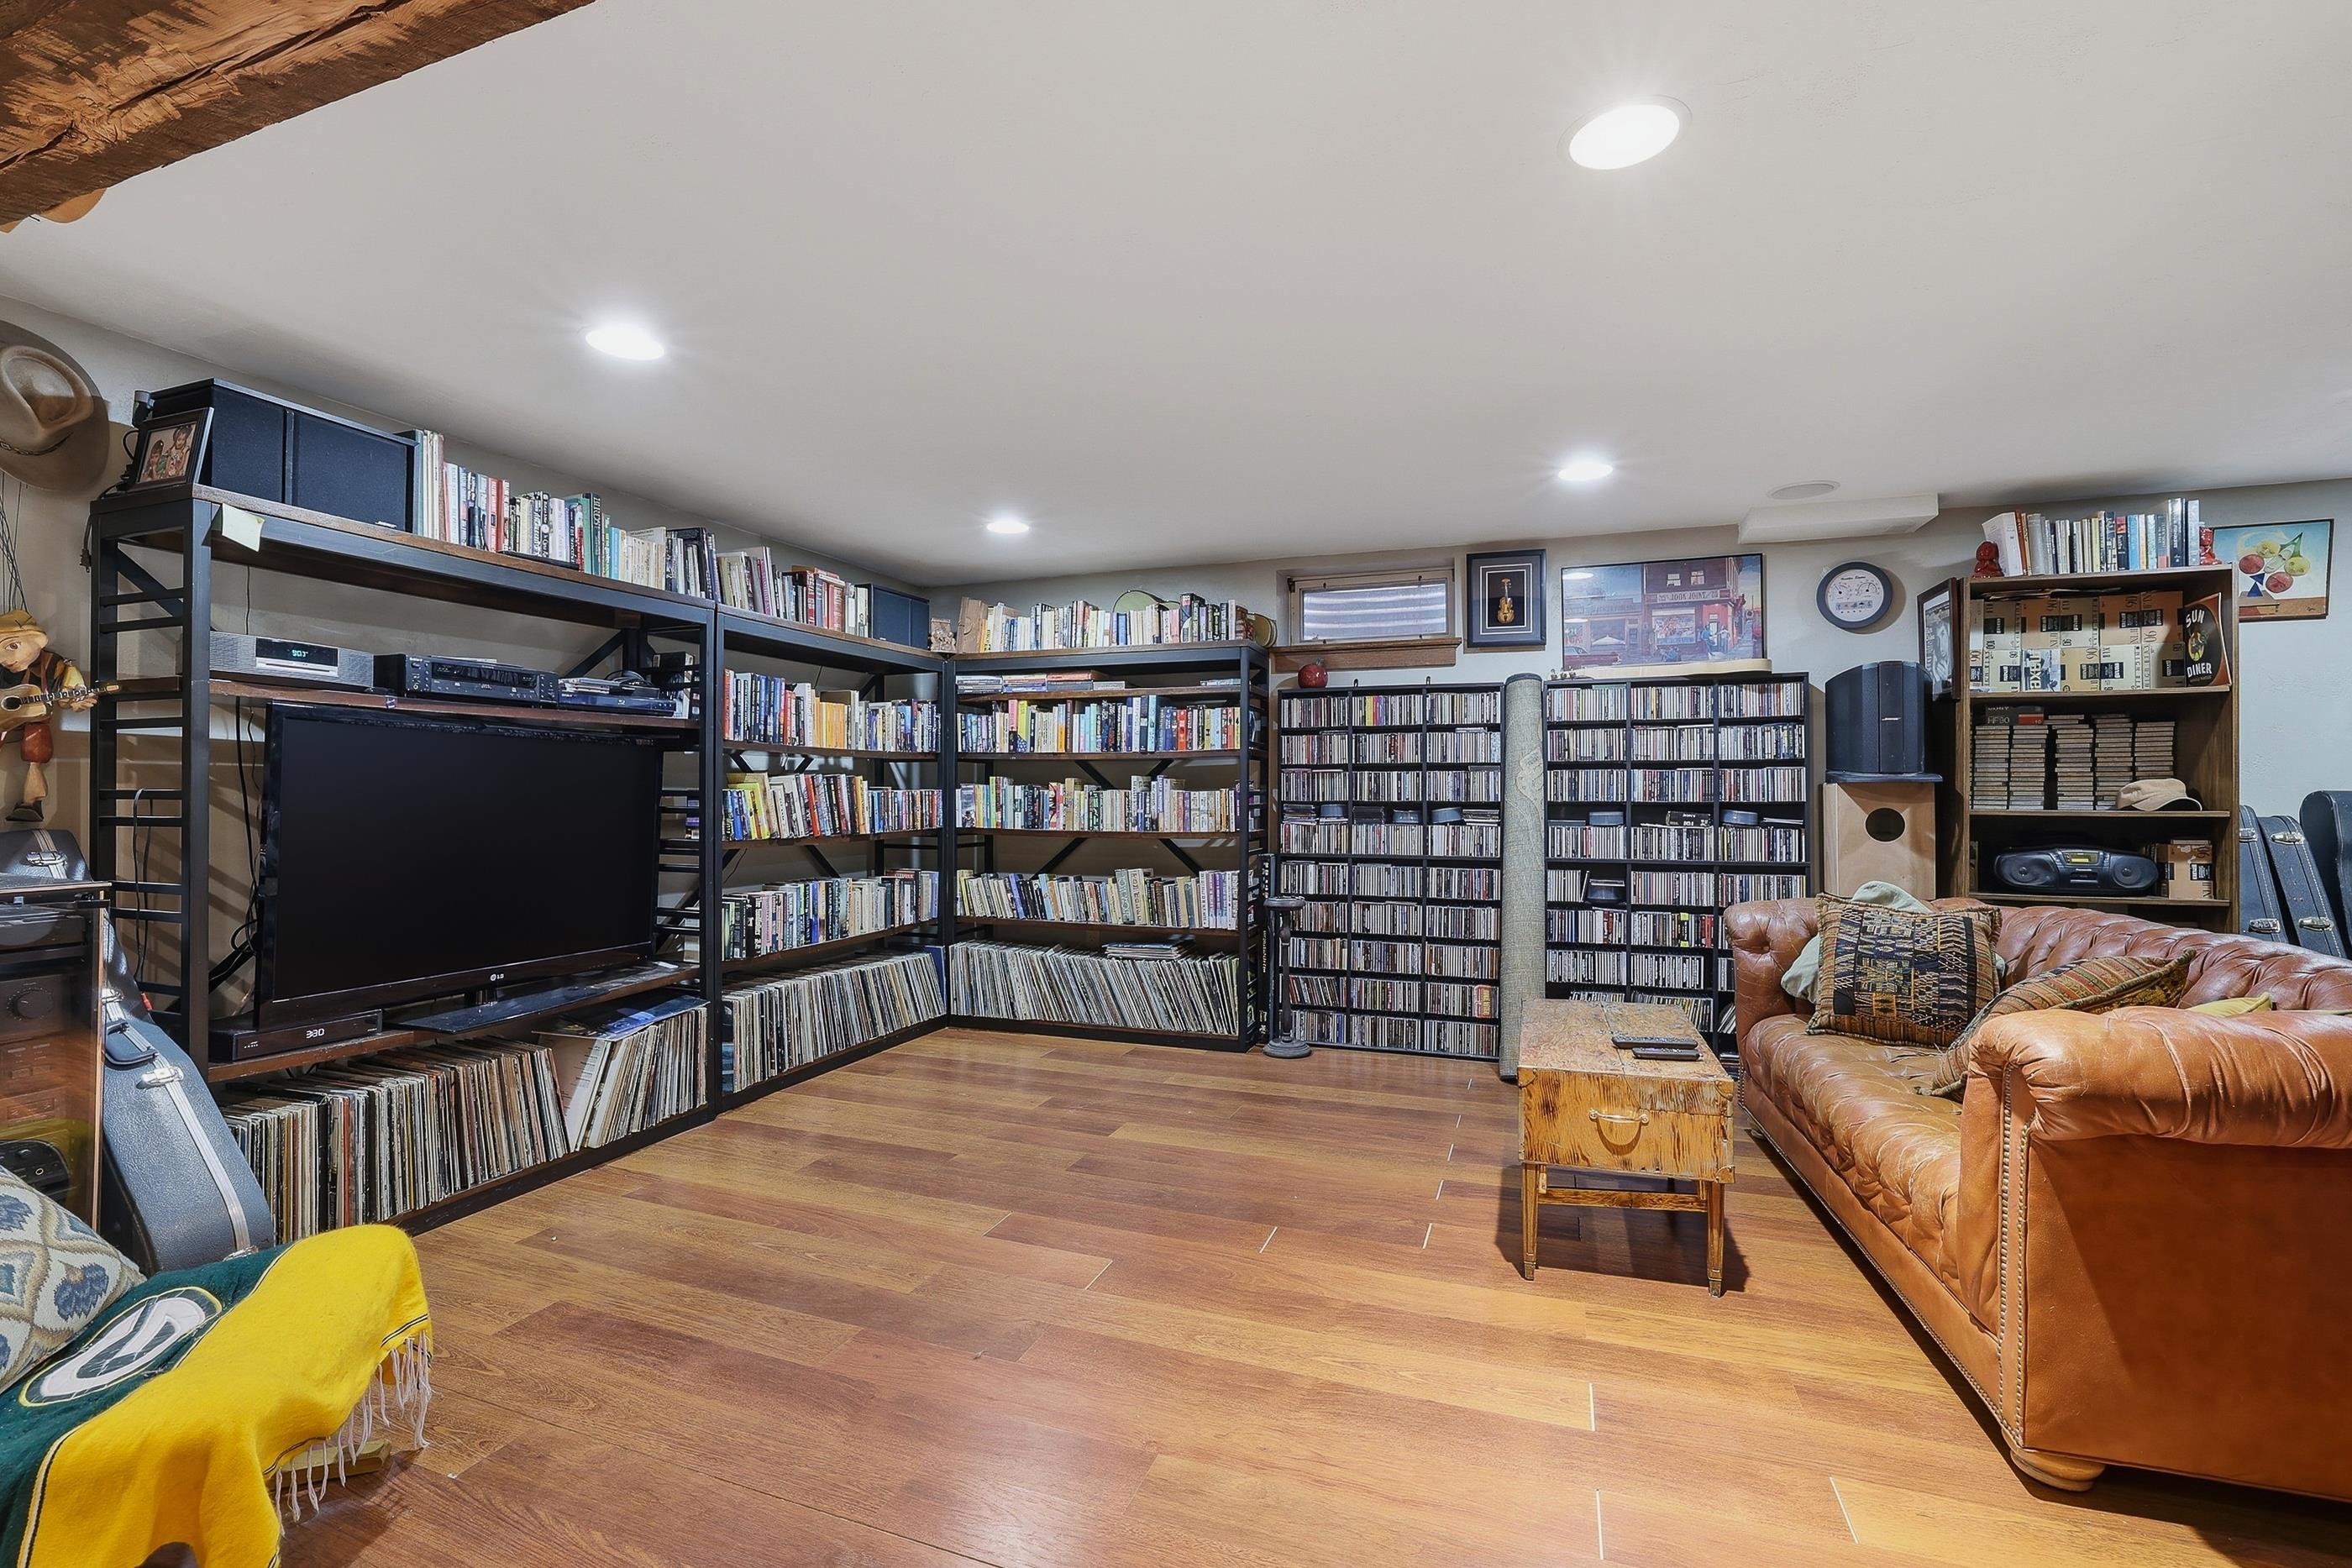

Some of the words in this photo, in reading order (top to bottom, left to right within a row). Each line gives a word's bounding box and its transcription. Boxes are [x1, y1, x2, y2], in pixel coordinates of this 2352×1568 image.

[2186, 609, 2205, 629] SUN
[2145, 631, 2158, 642] 90
[2087, 648, 2098, 659] 90
[2187, 662, 2213, 678] DINER
